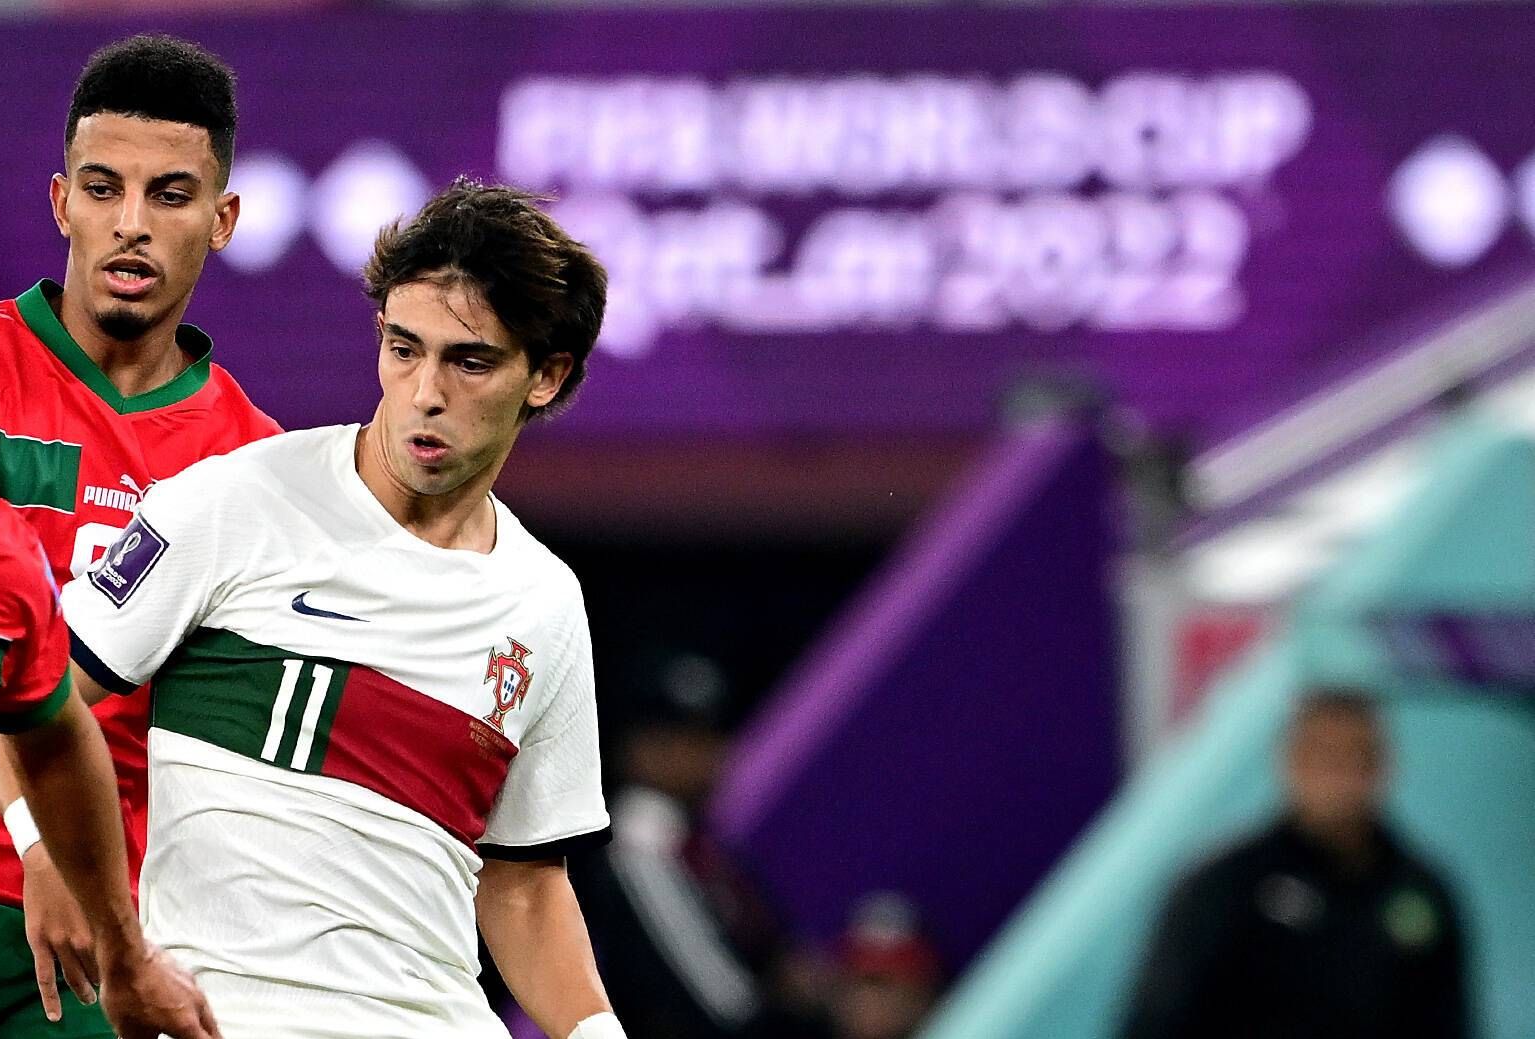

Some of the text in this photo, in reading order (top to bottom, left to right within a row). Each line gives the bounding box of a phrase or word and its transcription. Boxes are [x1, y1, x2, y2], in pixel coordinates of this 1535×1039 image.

[1098, 74, 1311, 188] CUP
[934, 192, 1250, 332] 2022
[83, 485, 137, 512] PUMA
[260, 659, 334, 771] 11
